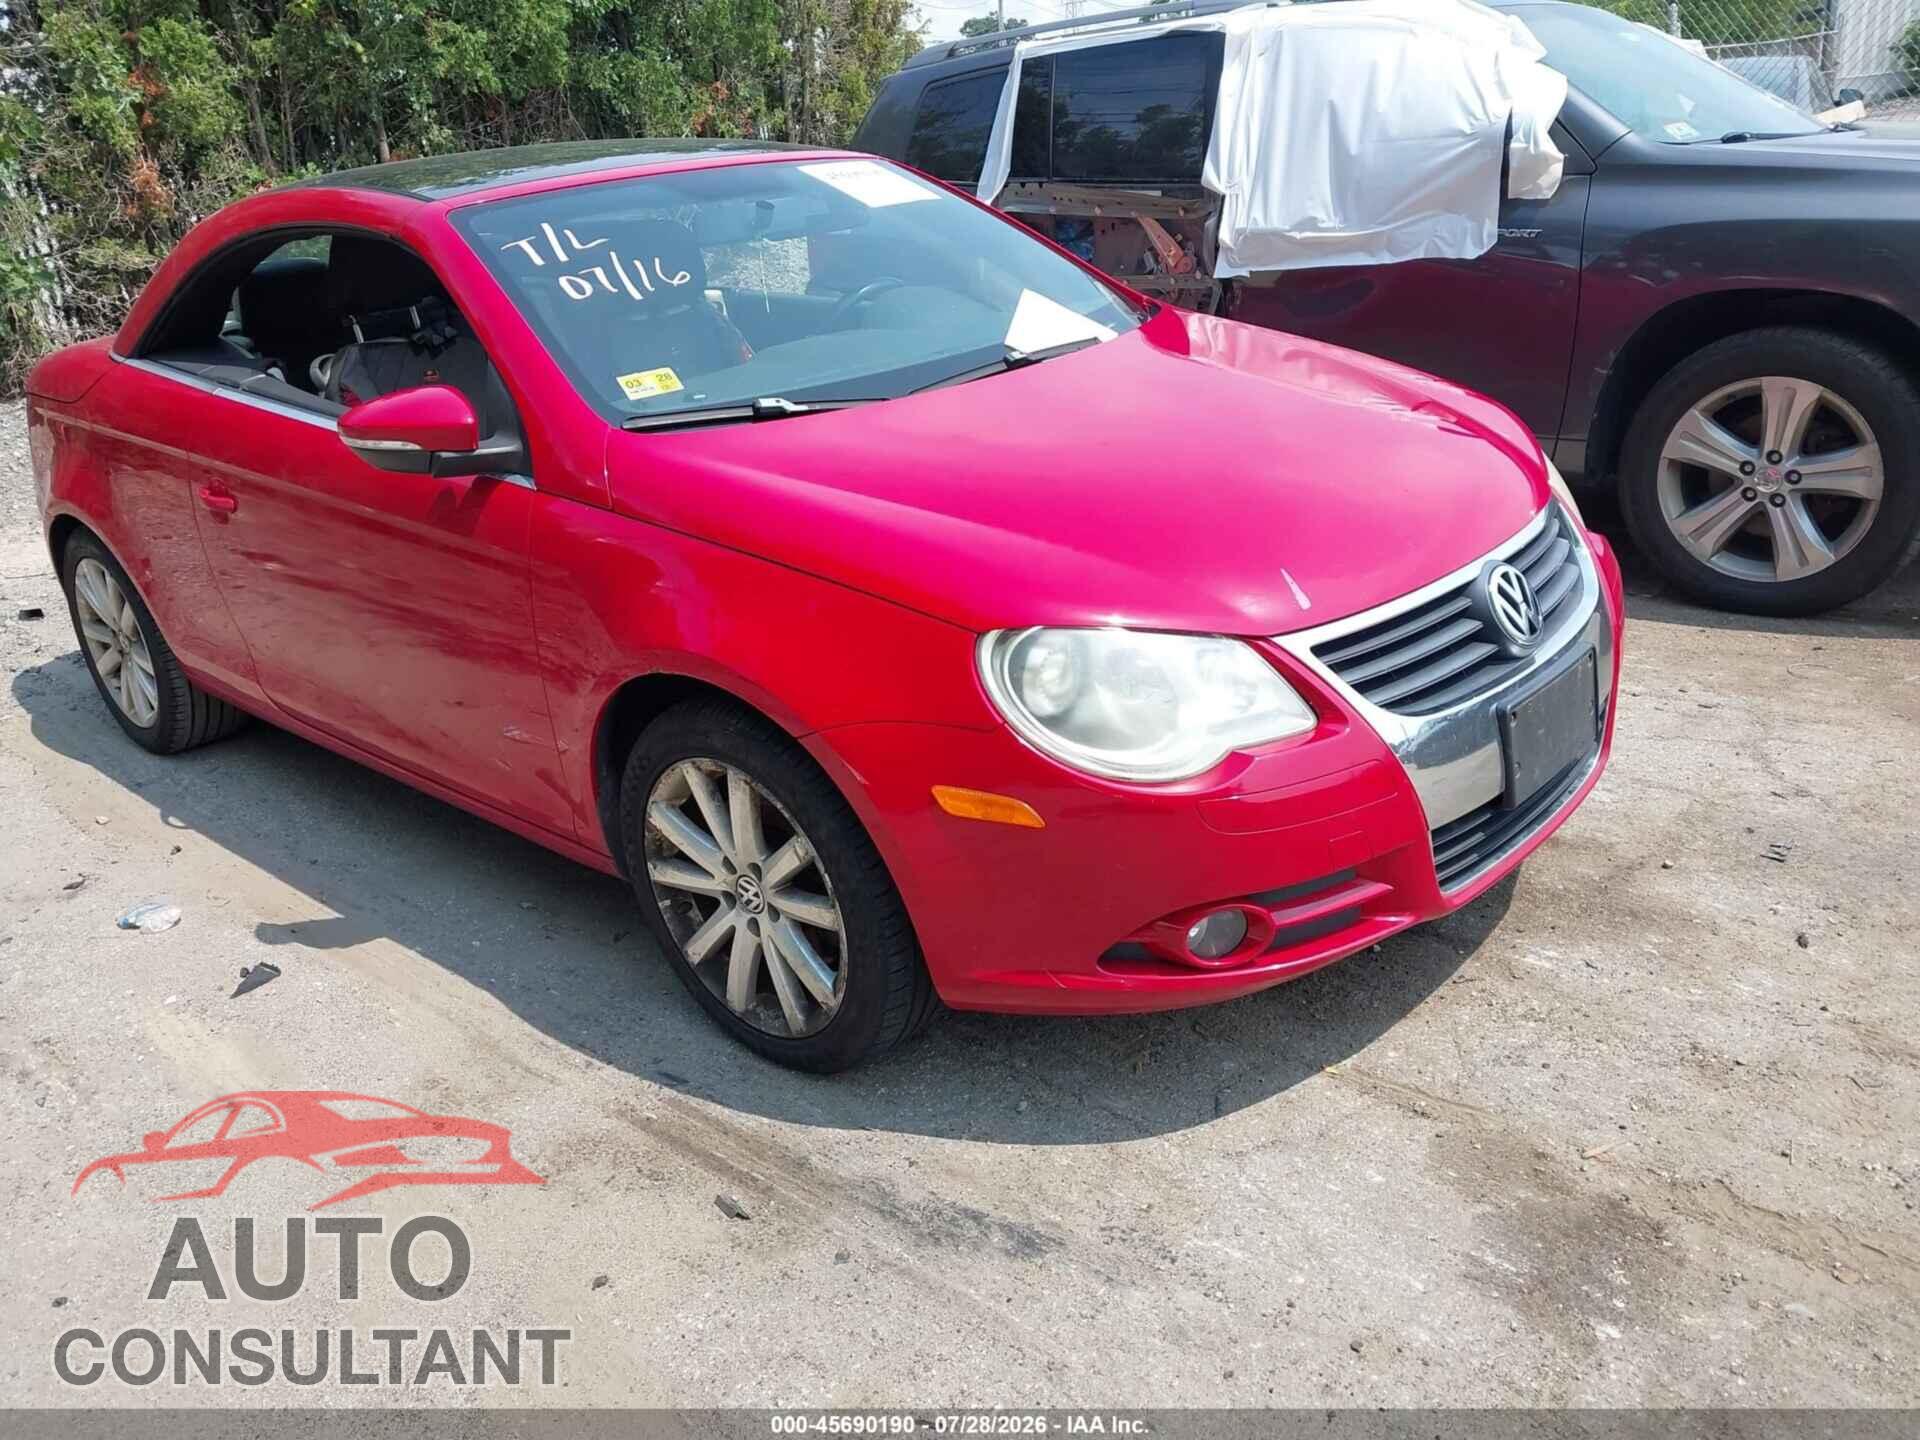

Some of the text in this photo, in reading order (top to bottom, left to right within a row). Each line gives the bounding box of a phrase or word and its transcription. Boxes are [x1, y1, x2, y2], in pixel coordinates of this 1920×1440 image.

[500, 222, 610, 266] T/L
[558, 250, 691, 300] 07/16
[1488, 564, 1541, 643] VW
